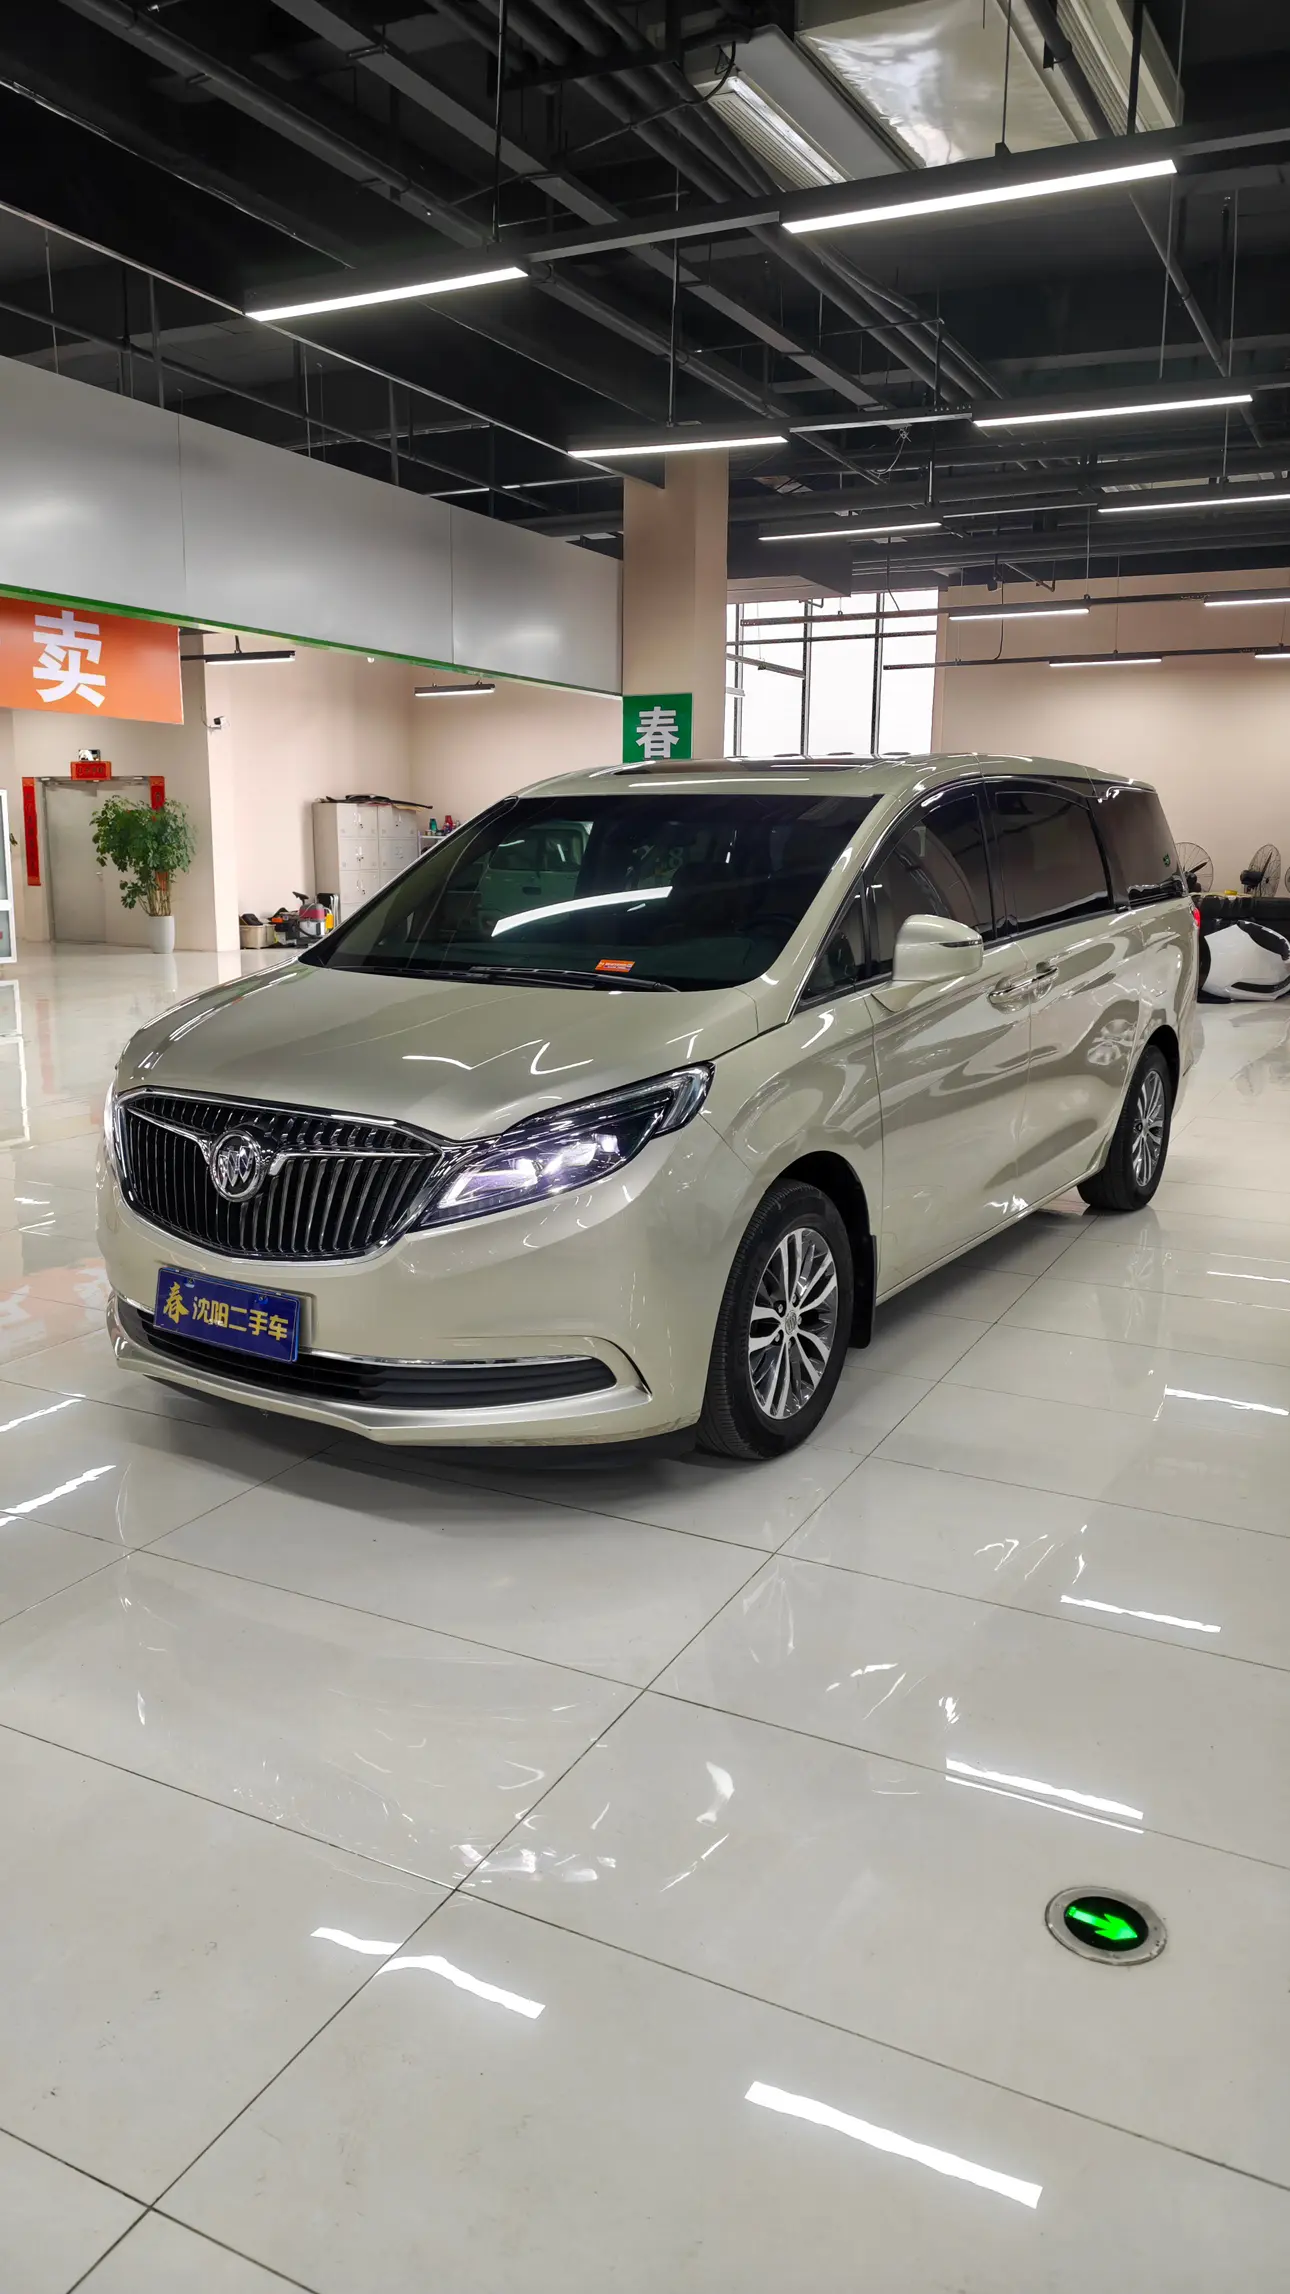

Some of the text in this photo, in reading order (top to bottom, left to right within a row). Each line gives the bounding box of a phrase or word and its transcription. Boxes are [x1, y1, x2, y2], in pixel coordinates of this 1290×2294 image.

[33, 610, 106, 708] 卖
[635, 706, 680, 759] 春
[163, 1281, 288, 1341] 春 沈阳二手车
